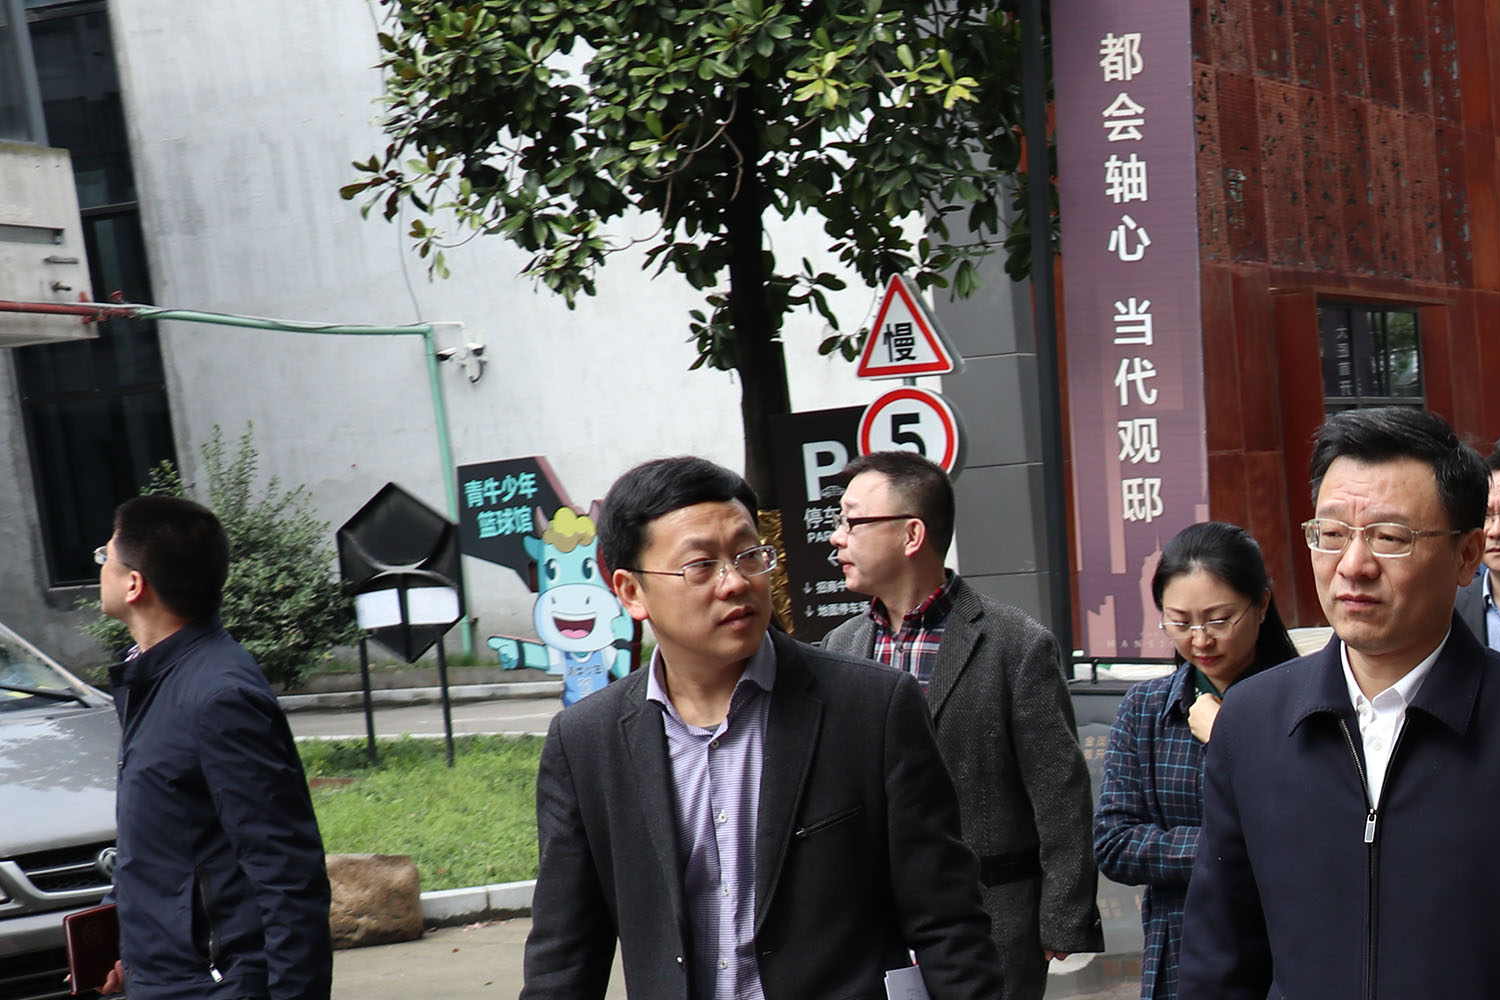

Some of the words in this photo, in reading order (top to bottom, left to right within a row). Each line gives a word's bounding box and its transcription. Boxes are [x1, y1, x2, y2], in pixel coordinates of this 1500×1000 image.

[1099, 32, 1152, 262] 都会轴心
[883, 322, 917, 363] 慢
[1113, 297, 1165, 524] 当代观邸
[891, 412, 927, 459] 5
[464, 472, 538, 508] 青牛少年
[802, 440, 849, 502] P
[477, 505, 533, 539] 篮球馆
